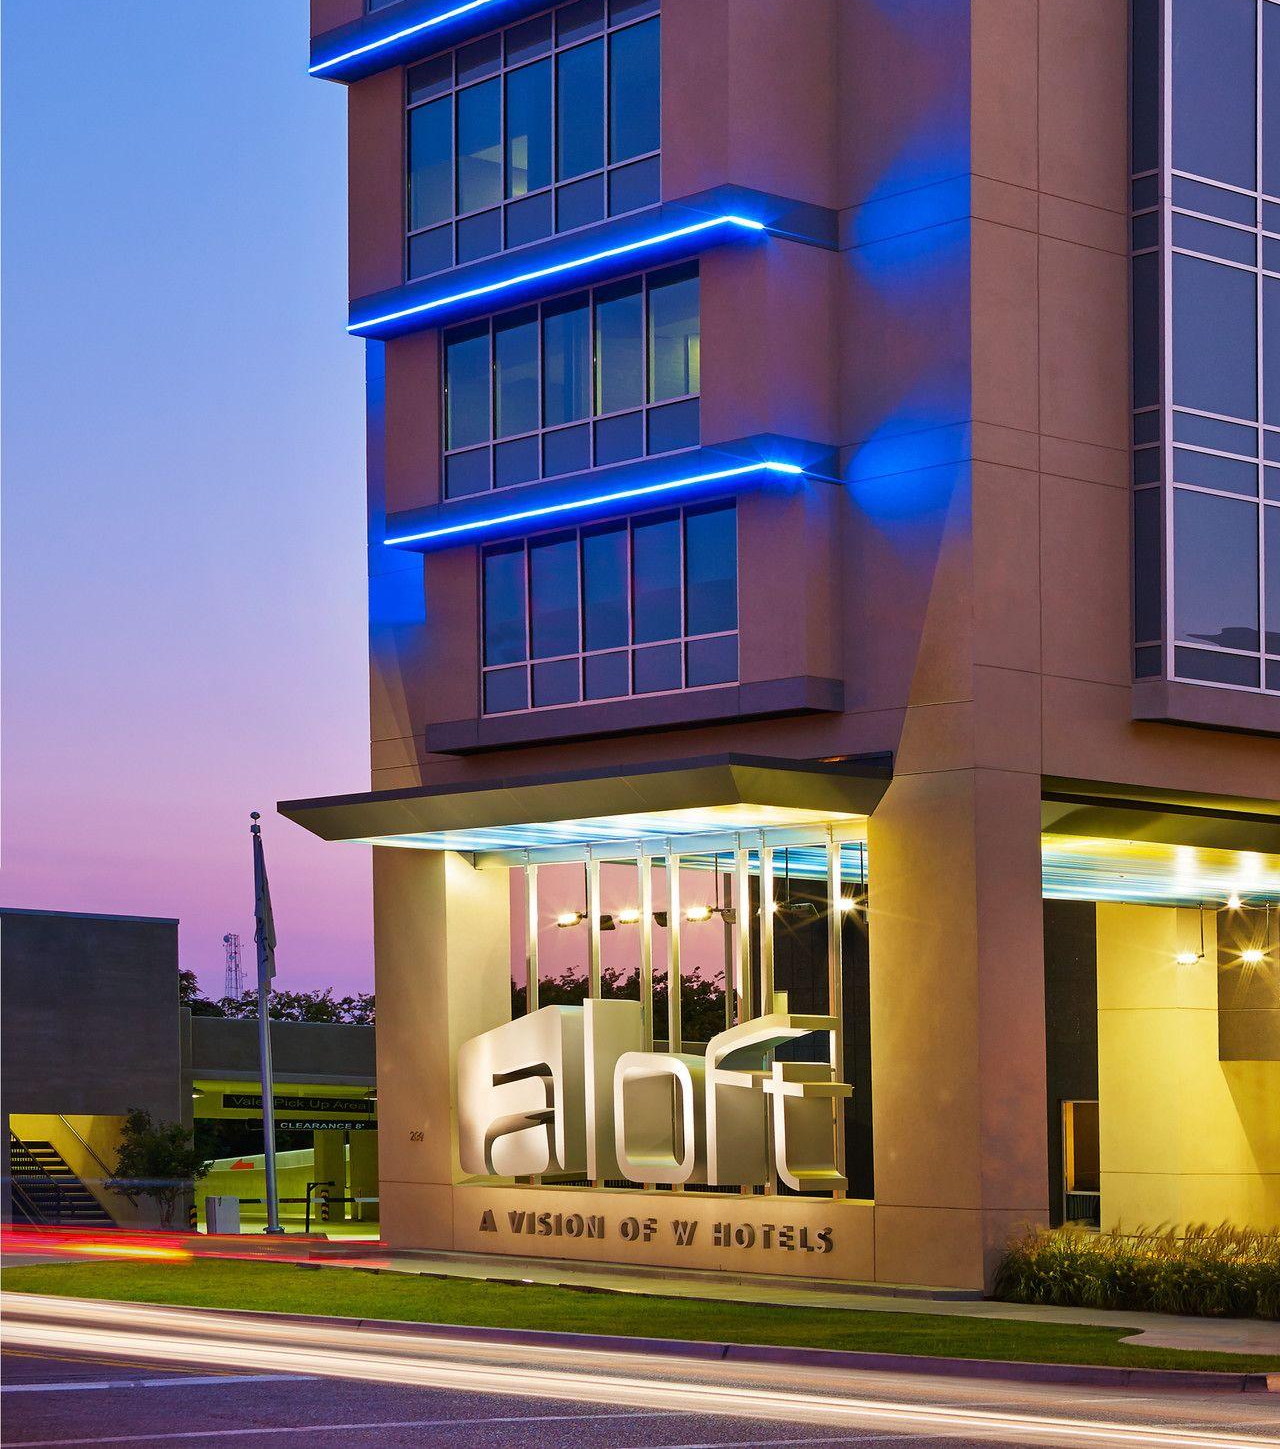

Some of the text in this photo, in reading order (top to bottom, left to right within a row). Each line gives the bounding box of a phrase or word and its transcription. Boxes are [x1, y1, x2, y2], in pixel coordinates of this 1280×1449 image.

[232, 1096, 367, 1109] Vale Pick Up Area
[459, 998, 852, 1192] aloft
[280, 1122, 351, 1130] CLEARANCE
[479, 1209, 835, 1254] A VISION OF W HOTELS
